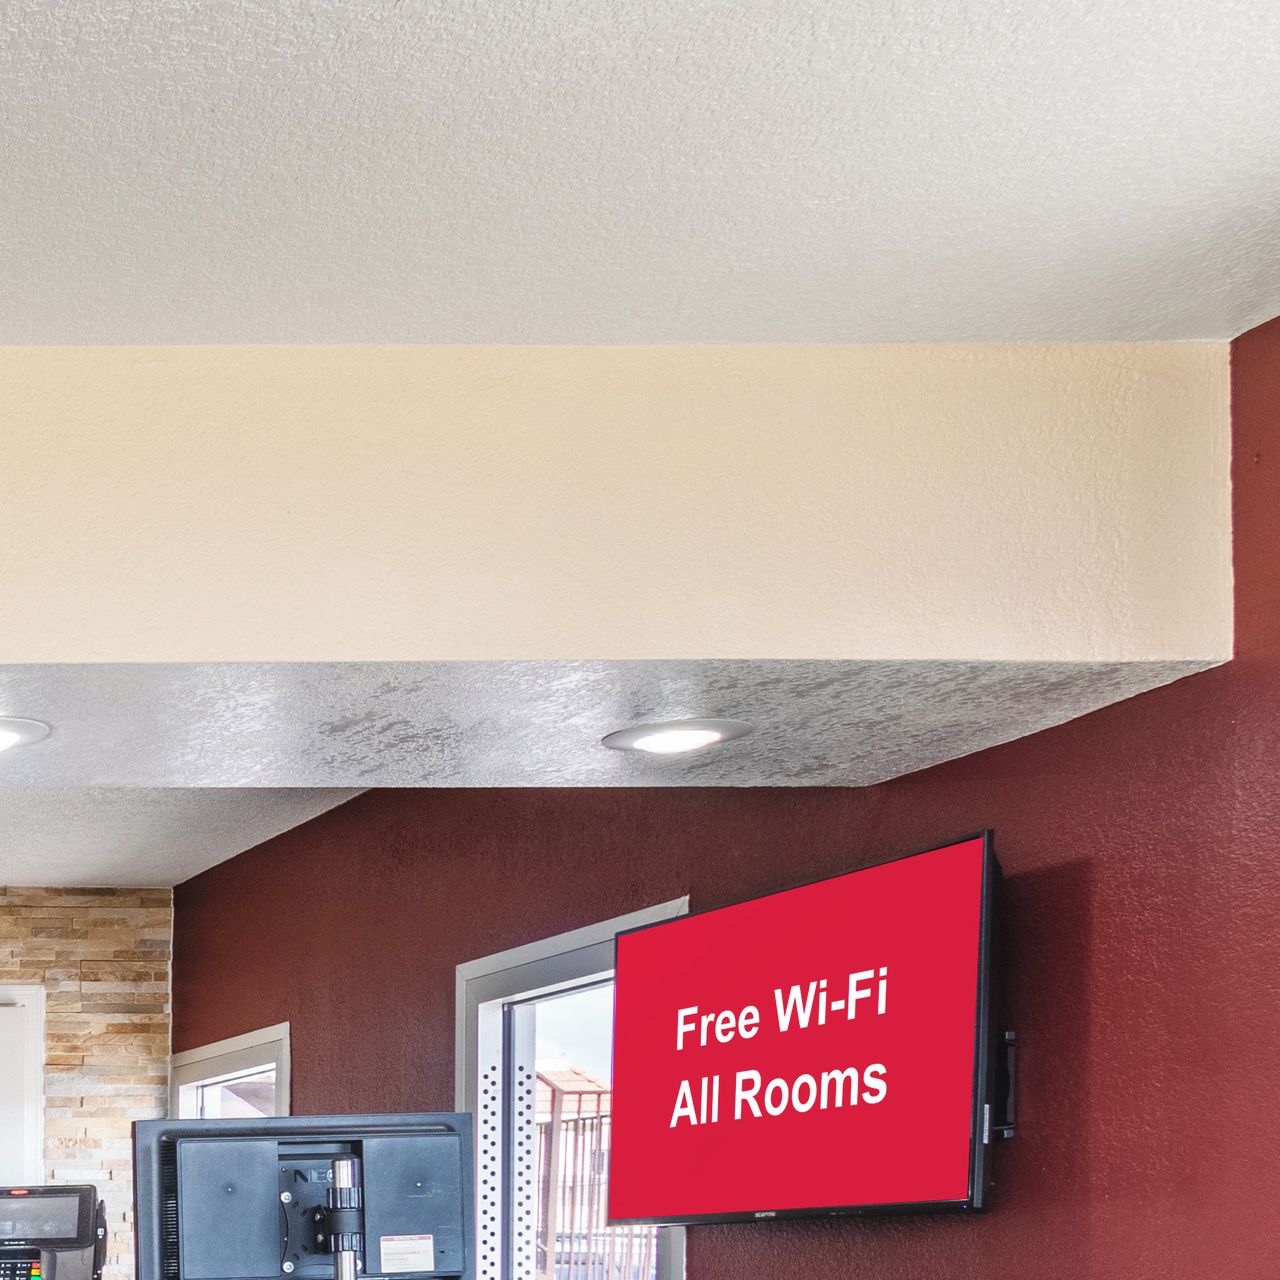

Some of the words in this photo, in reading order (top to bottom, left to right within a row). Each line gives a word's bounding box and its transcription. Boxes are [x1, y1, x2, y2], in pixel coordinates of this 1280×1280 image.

[676, 1005, 760, 1051] Free
[773, 966, 888, 1033] Wi-Fi
[669, 1074, 720, 1129] All
[734, 1063, 888, 1121] Rooms
